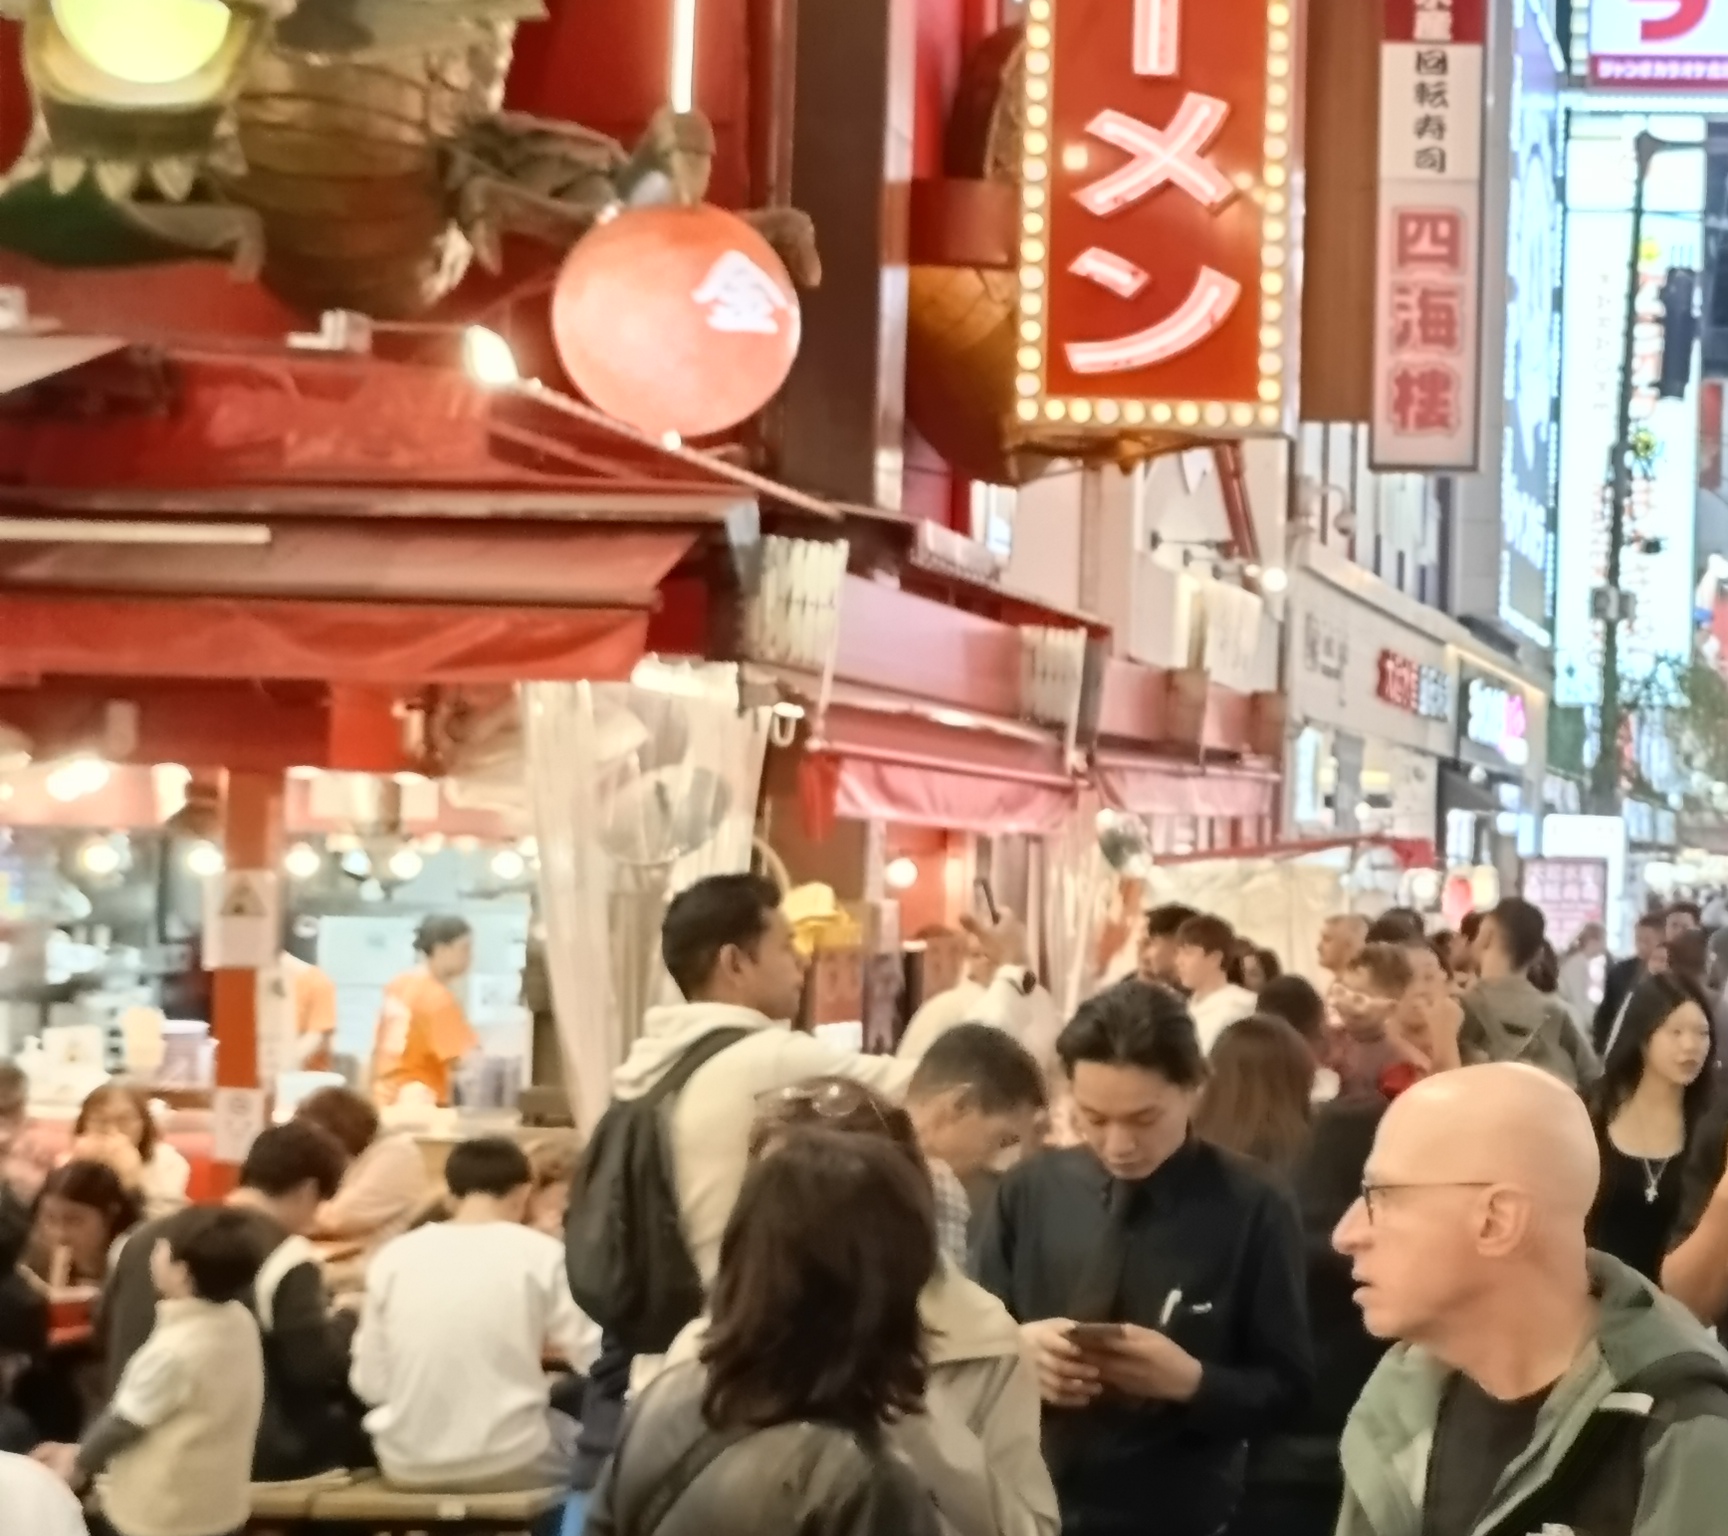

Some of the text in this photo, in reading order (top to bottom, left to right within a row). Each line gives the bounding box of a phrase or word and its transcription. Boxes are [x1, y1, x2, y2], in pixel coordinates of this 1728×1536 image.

[1413, 49, 1450, 175] 回転寿司
[690, 248, 789, 334] 金
